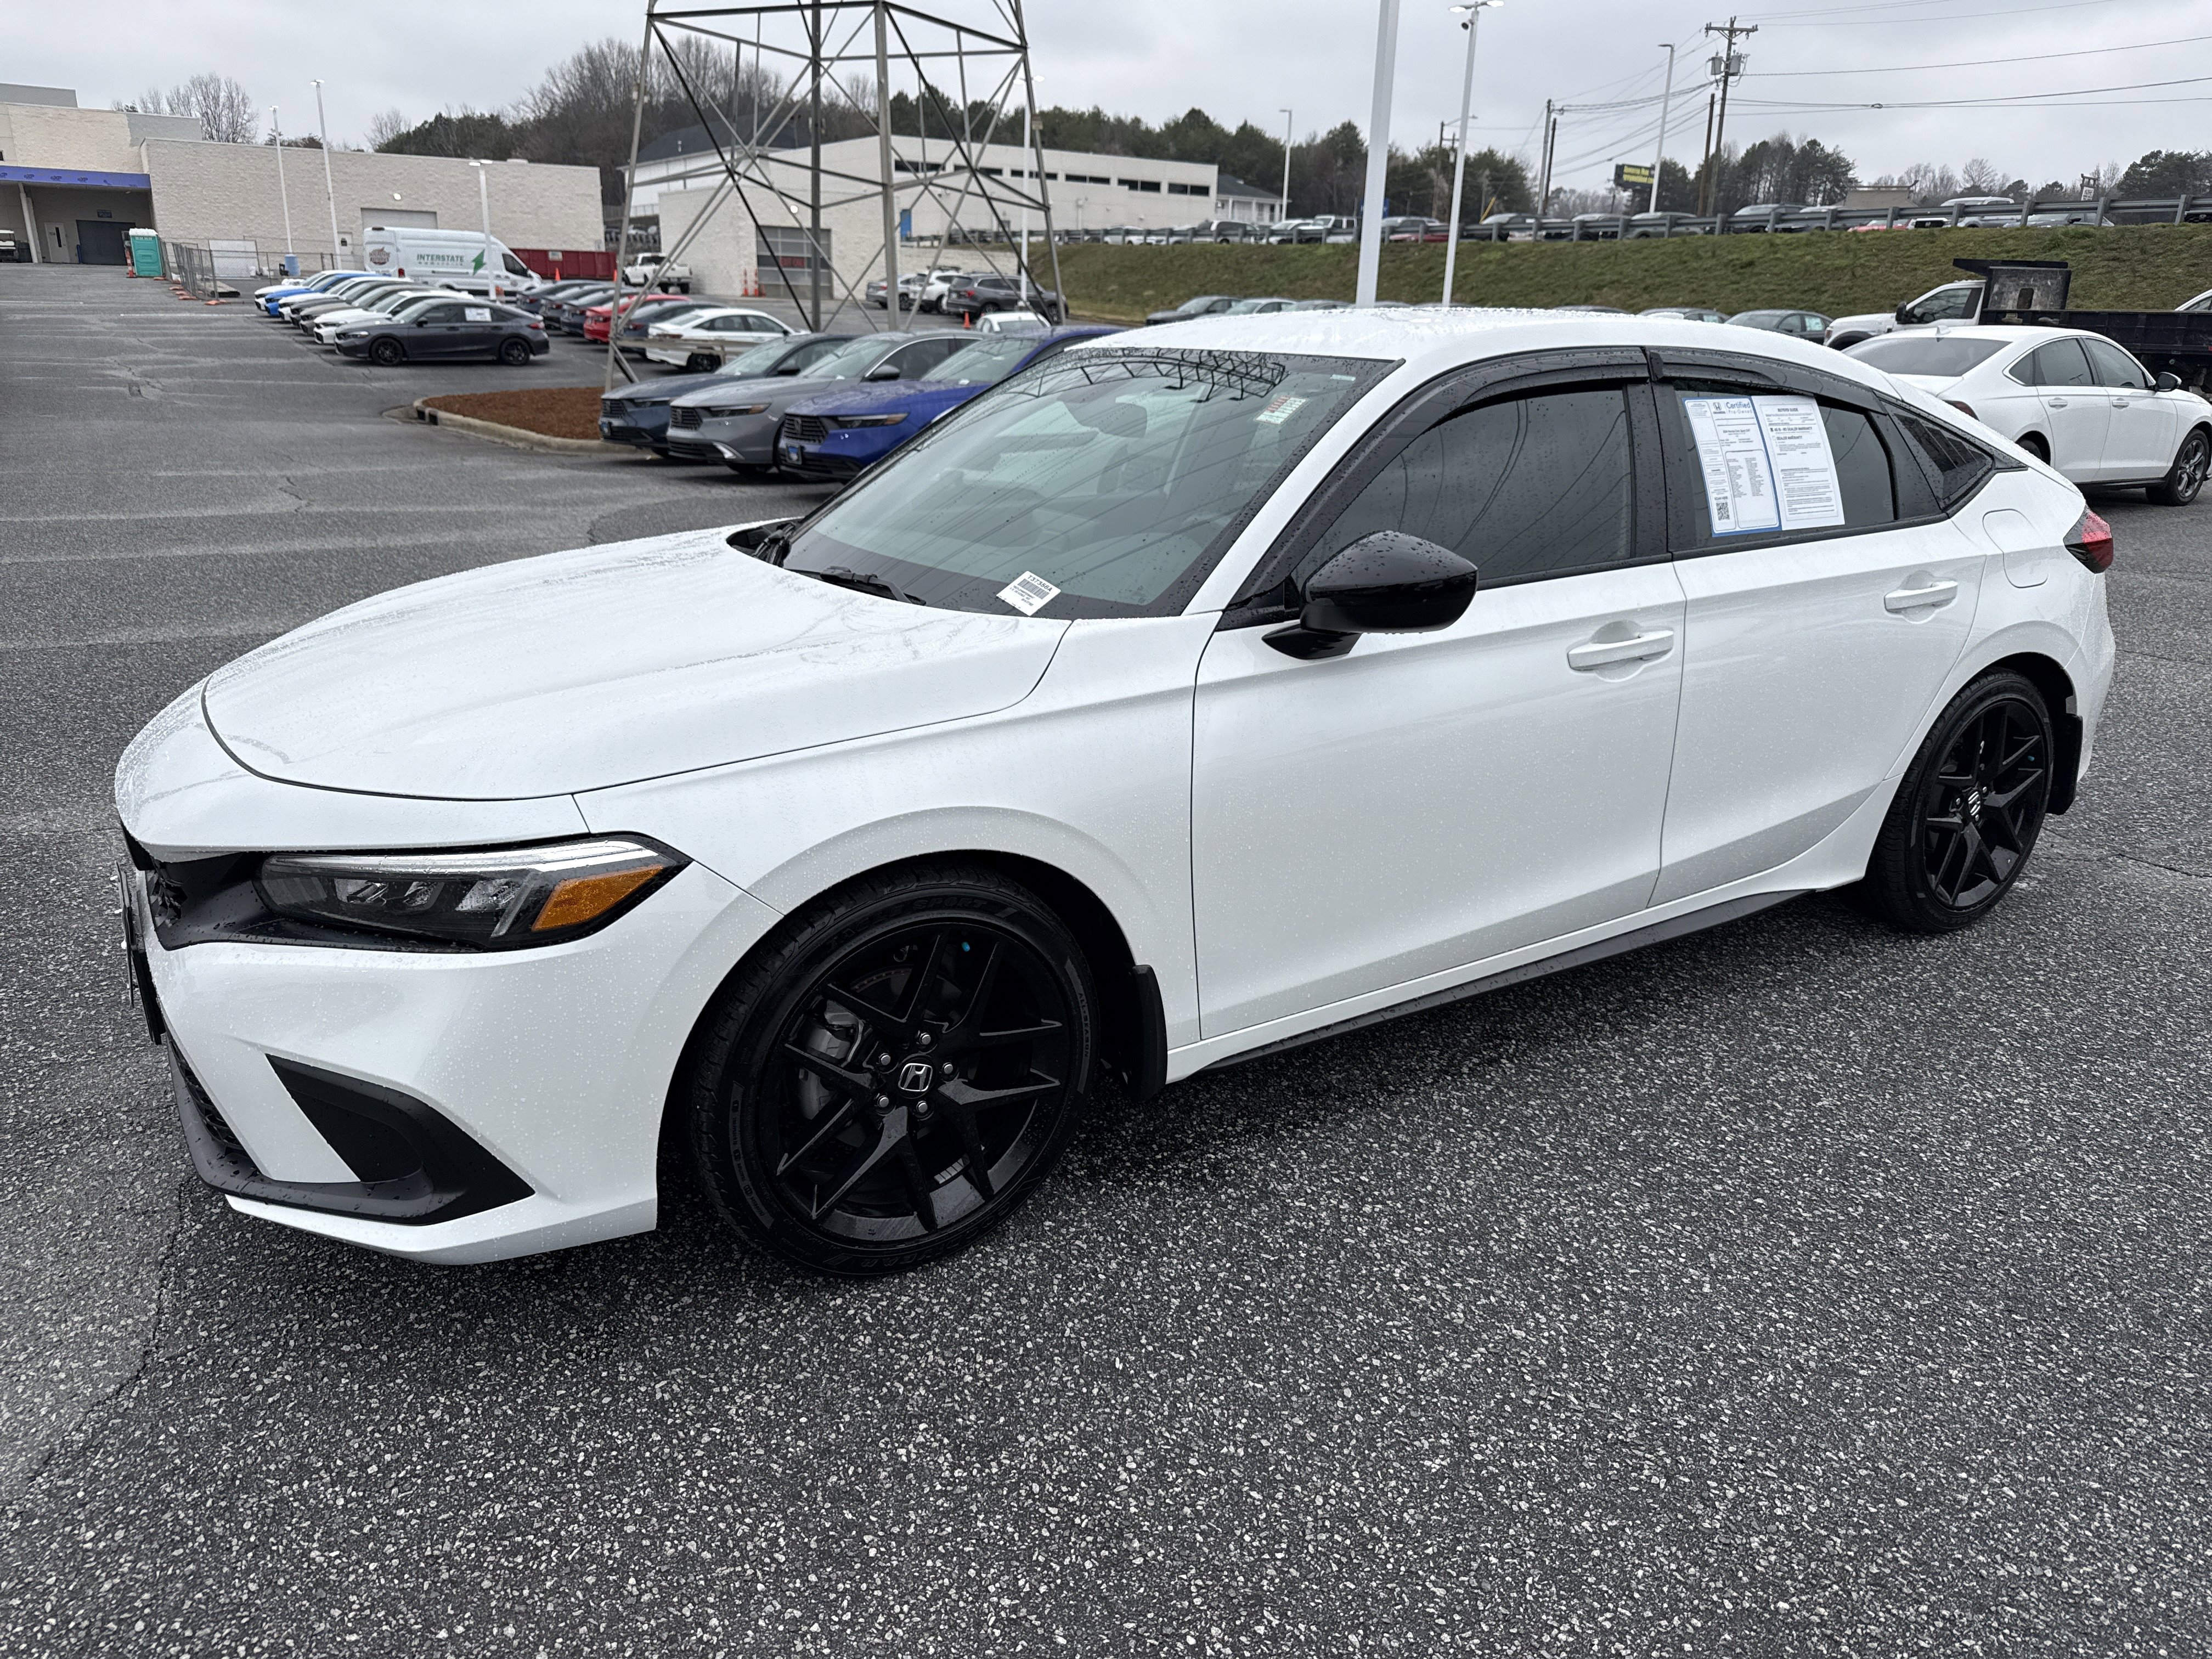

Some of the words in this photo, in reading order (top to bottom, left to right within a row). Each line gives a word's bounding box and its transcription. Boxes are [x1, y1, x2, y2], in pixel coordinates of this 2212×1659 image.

[417, 254, 464, 262] INTERSTATE
[1028, 574, 1053, 592] T37356A
[912, 896, 989, 910] SPORT
